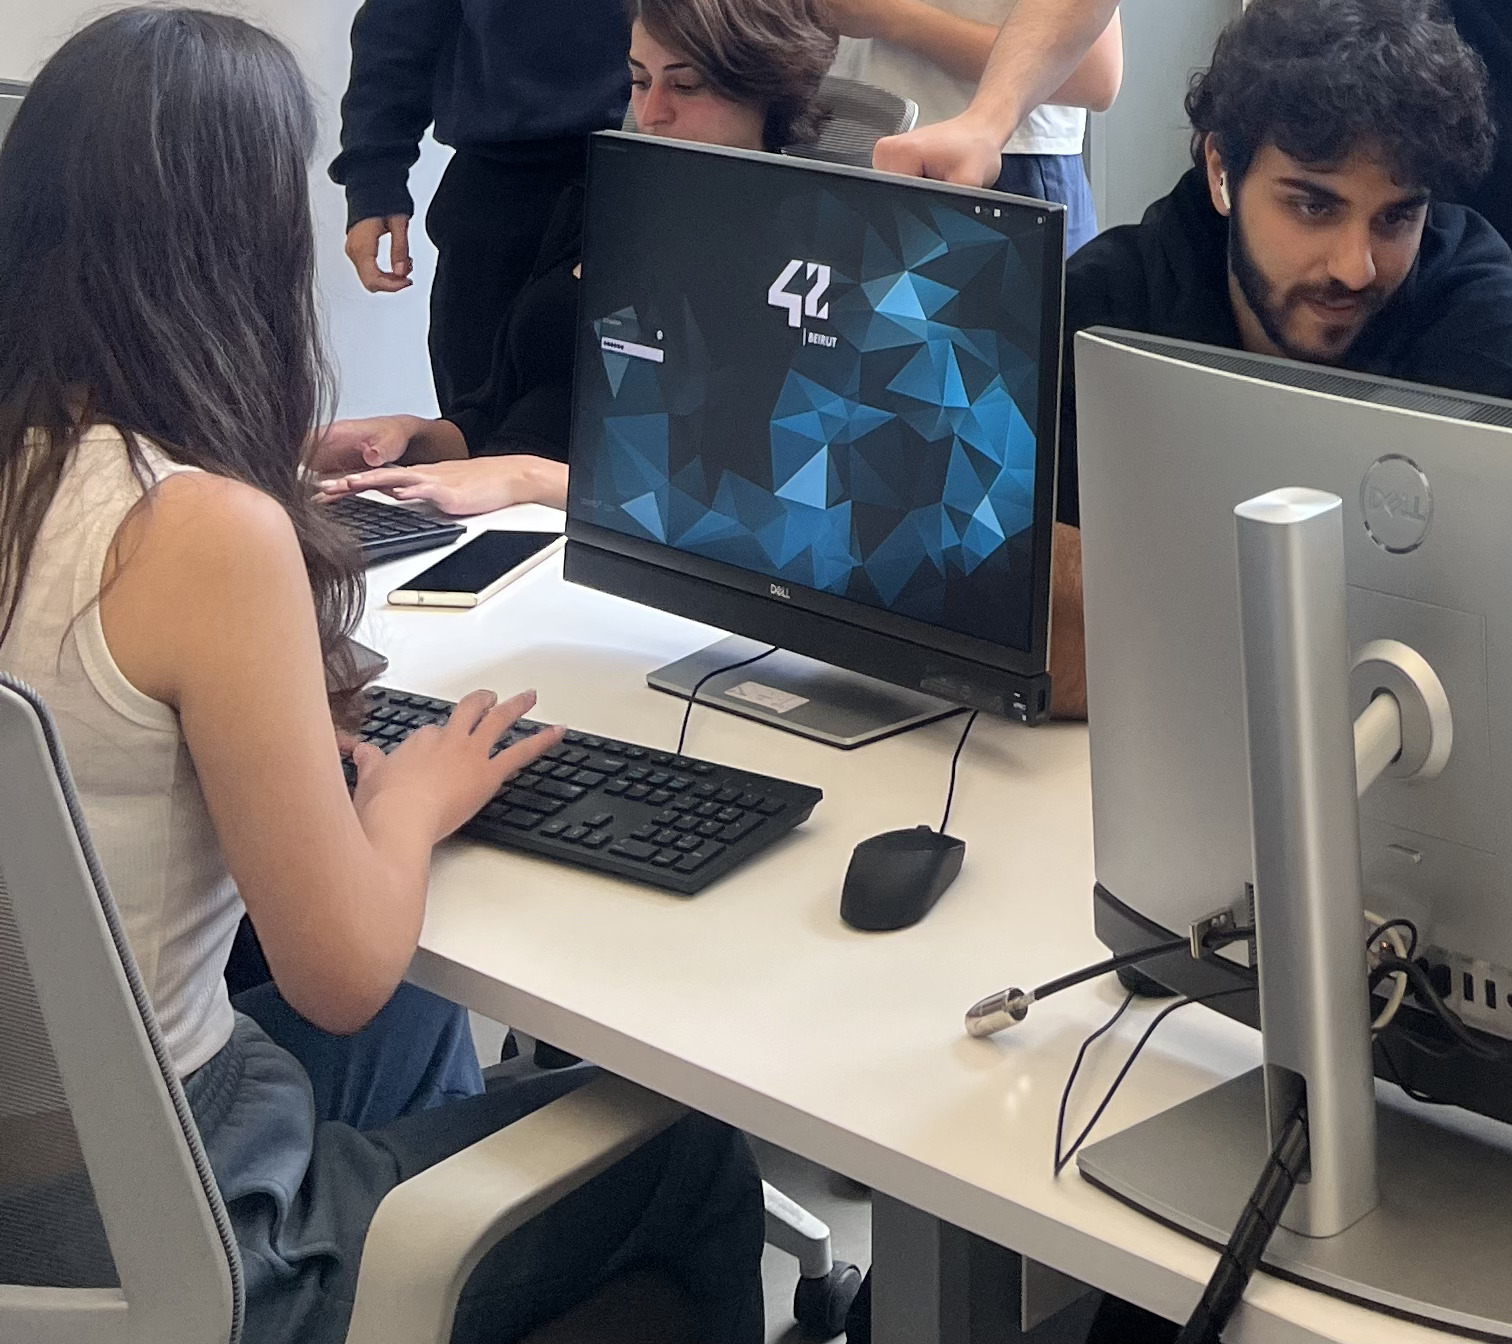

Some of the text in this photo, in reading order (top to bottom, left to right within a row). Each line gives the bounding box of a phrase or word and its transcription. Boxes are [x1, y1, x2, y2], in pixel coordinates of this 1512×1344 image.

[768, 259, 831, 328] 42
[807, 331, 838, 348] BEIRUT
[770, 583, 791, 599] DELL
